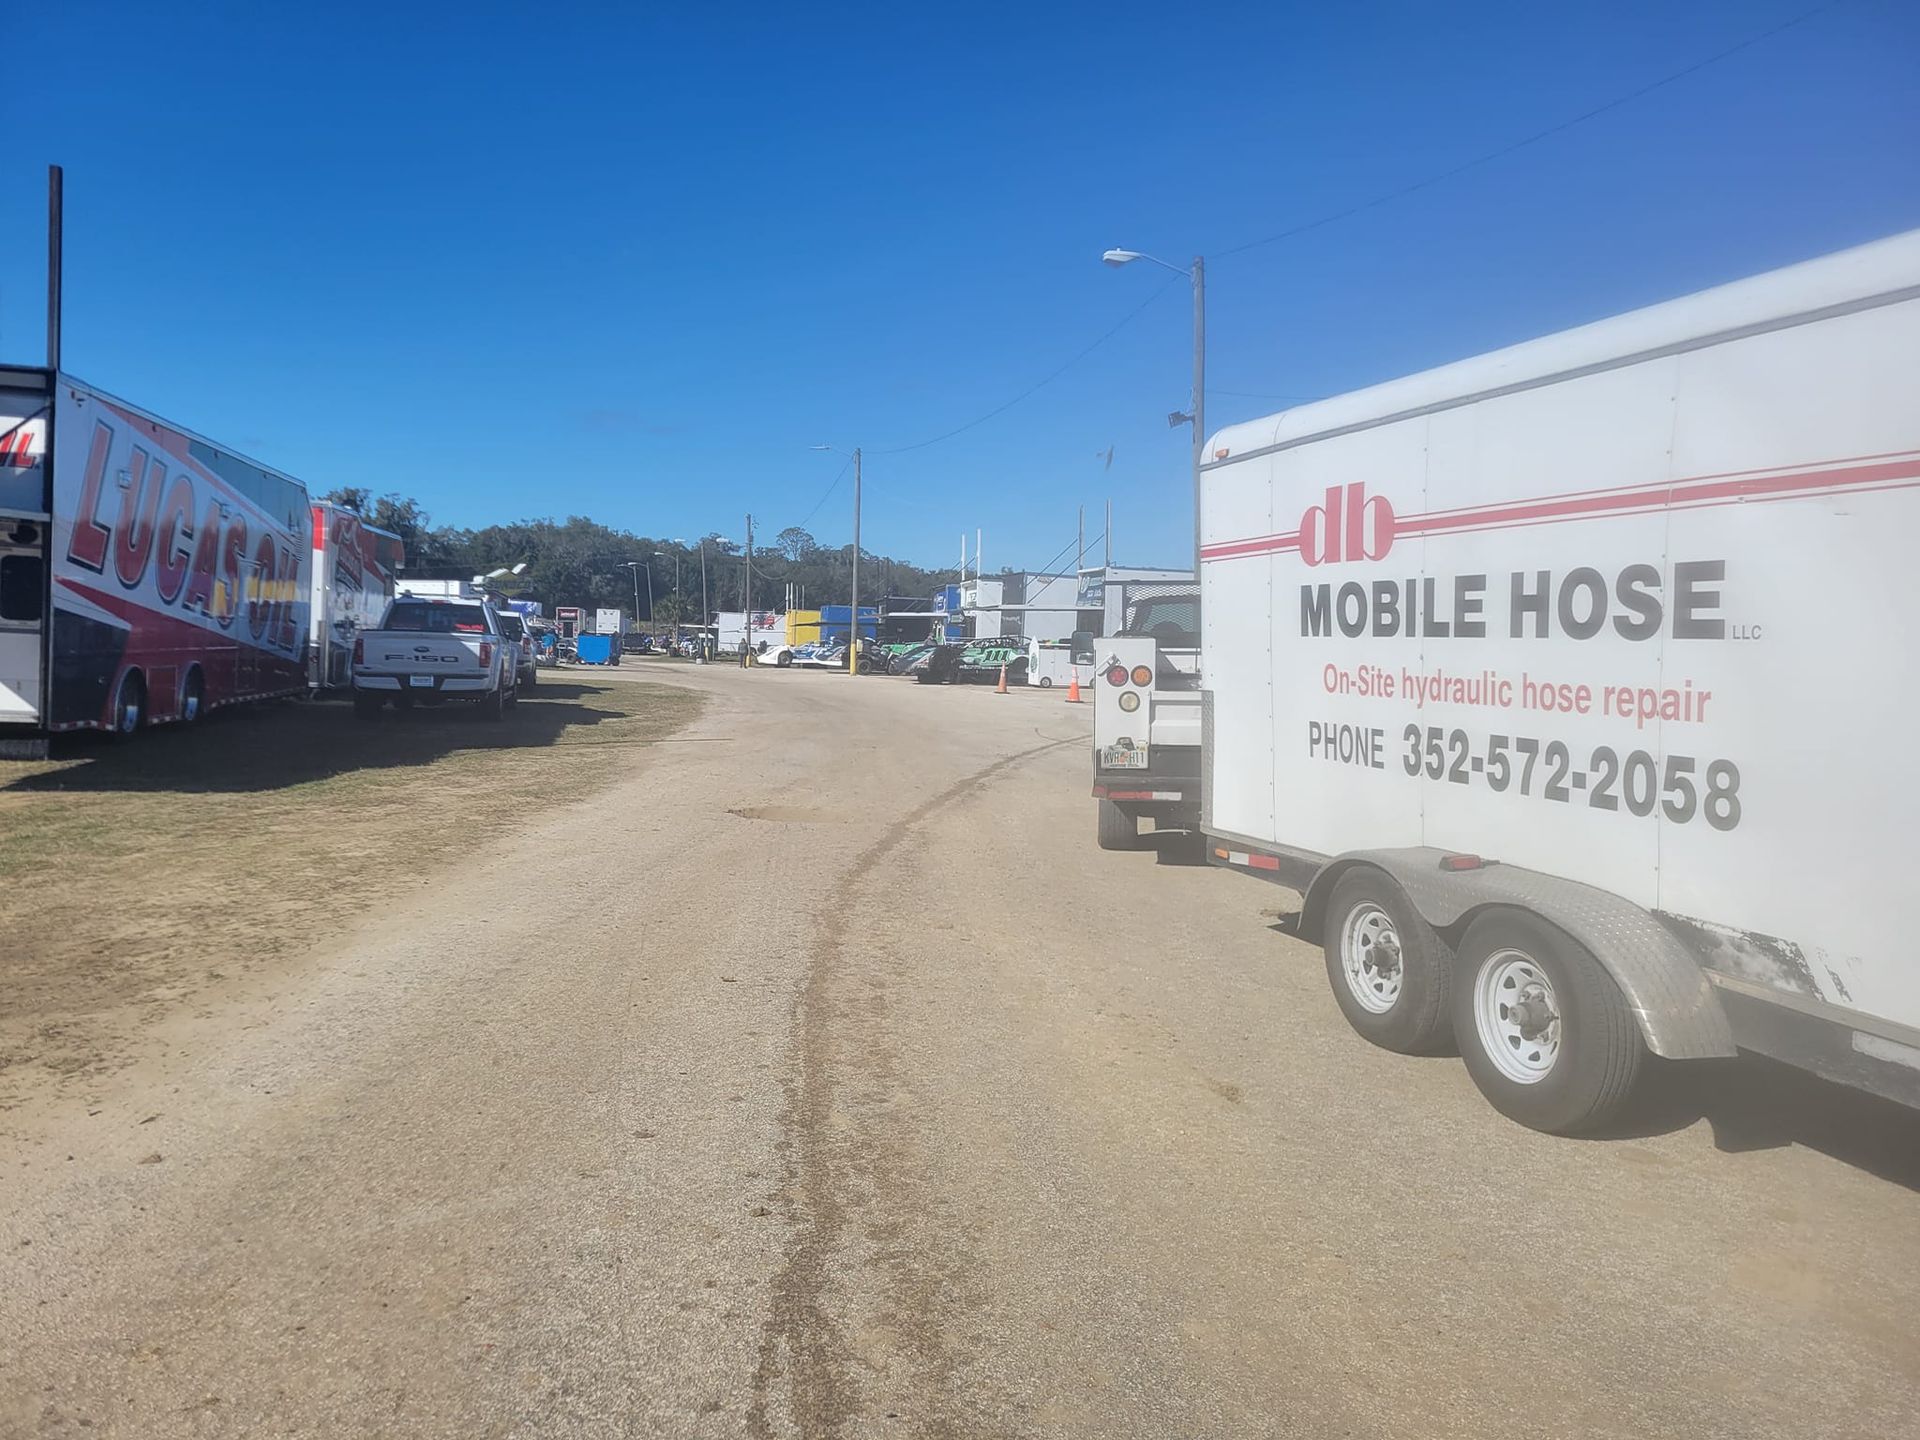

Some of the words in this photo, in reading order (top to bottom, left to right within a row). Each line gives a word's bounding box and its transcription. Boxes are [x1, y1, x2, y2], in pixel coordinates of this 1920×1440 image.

[66, 418, 247, 630] LUCAS
[249, 533, 302, 653] OIL
[1300, 481, 1394, 567] db
[1301, 574, 1486, 638] MOBILE
[1510, 560, 1725, 641] HOSE
[1732, 625, 1762, 640] LLC
[384, 654, 459, 663] F-150
[1323, 663, 1395, 698] On-Site
[1402, 667, 1512, 709] hydraulic
[1522, 672, 1592, 714] hose
[1603, 679, 1712, 729] repair
[1309, 721, 1384, 769] PHONE
[1403, 723, 1742, 831] 352-572-2058
